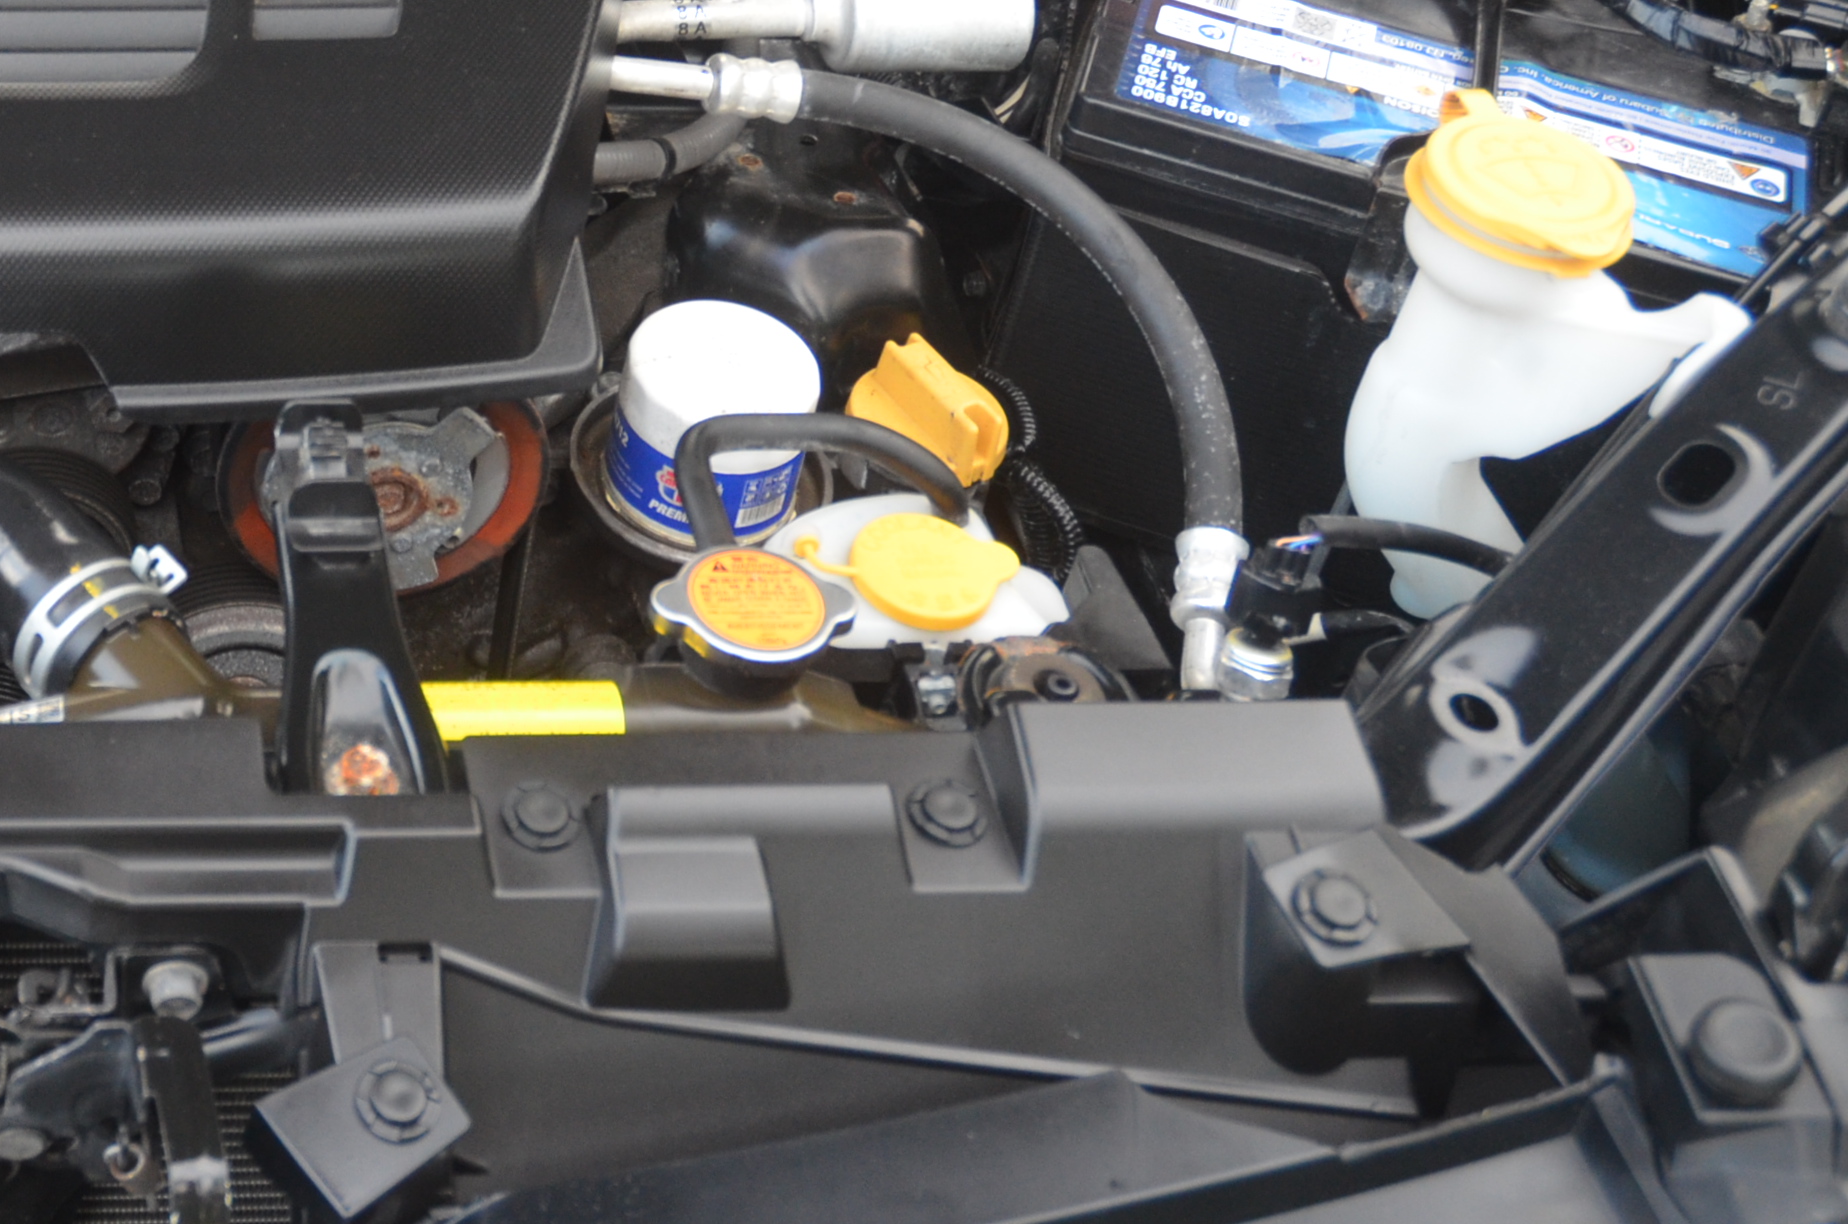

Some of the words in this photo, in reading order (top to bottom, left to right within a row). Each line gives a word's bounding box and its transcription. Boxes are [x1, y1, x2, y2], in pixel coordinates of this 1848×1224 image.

[678, 22, 688, 35] 8
[694, 21, 706, 33] A
[1143, 42, 1177, 60] EFB
[1136, 63, 1169, 80] 120
[1164, 59, 1190, 75] Ah
[1172, 73, 1198, 89] RC
[1169, 83, 1206, 102] CCA
[1618, 96, 1670, 117] Subaru
